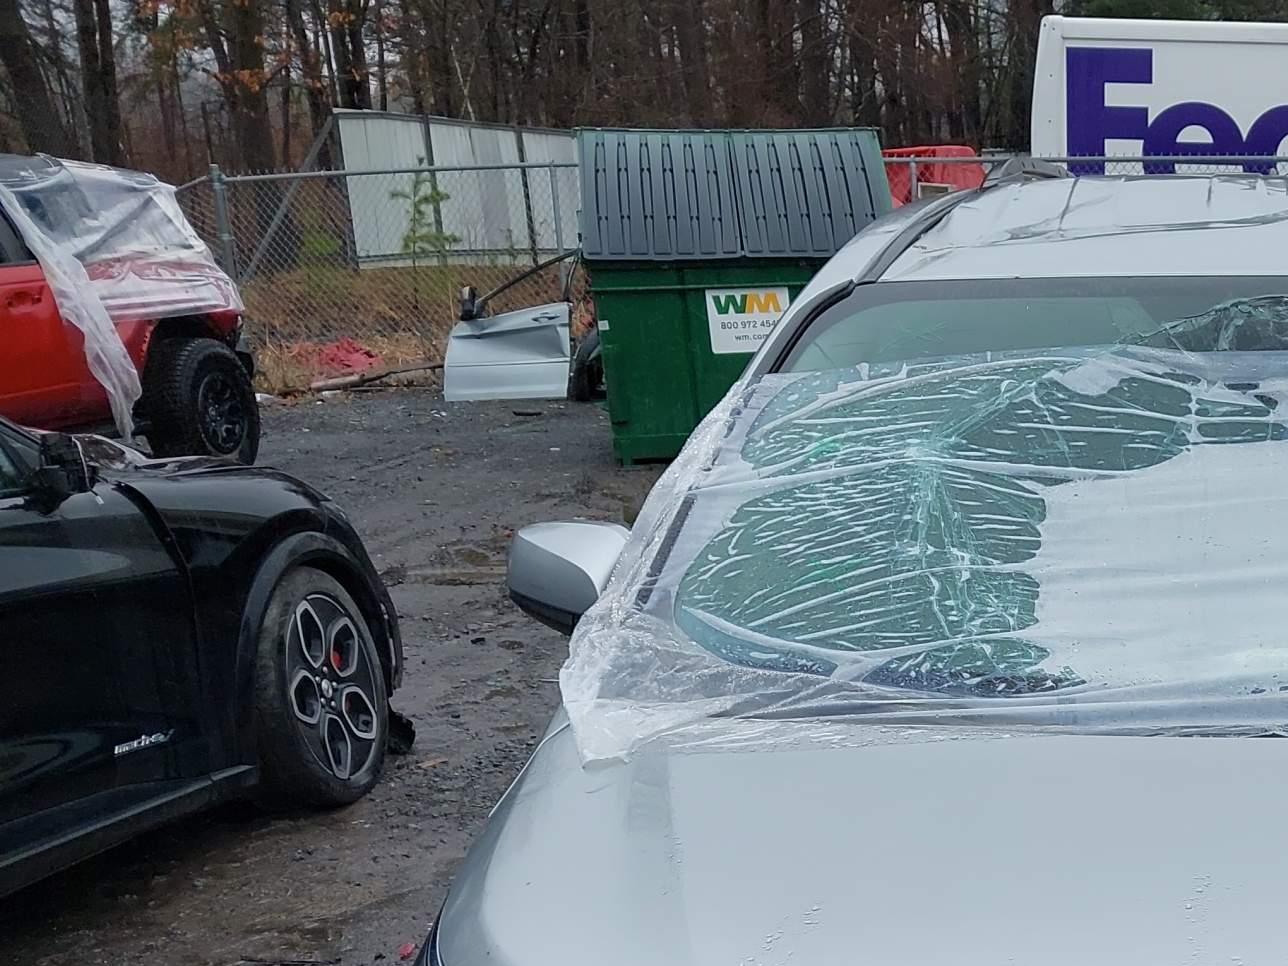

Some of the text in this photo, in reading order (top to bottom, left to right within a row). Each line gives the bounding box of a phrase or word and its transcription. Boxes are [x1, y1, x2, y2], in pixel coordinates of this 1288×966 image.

[711, 292, 781, 315] WM
[721, 319, 780, 330] 800 972 454
